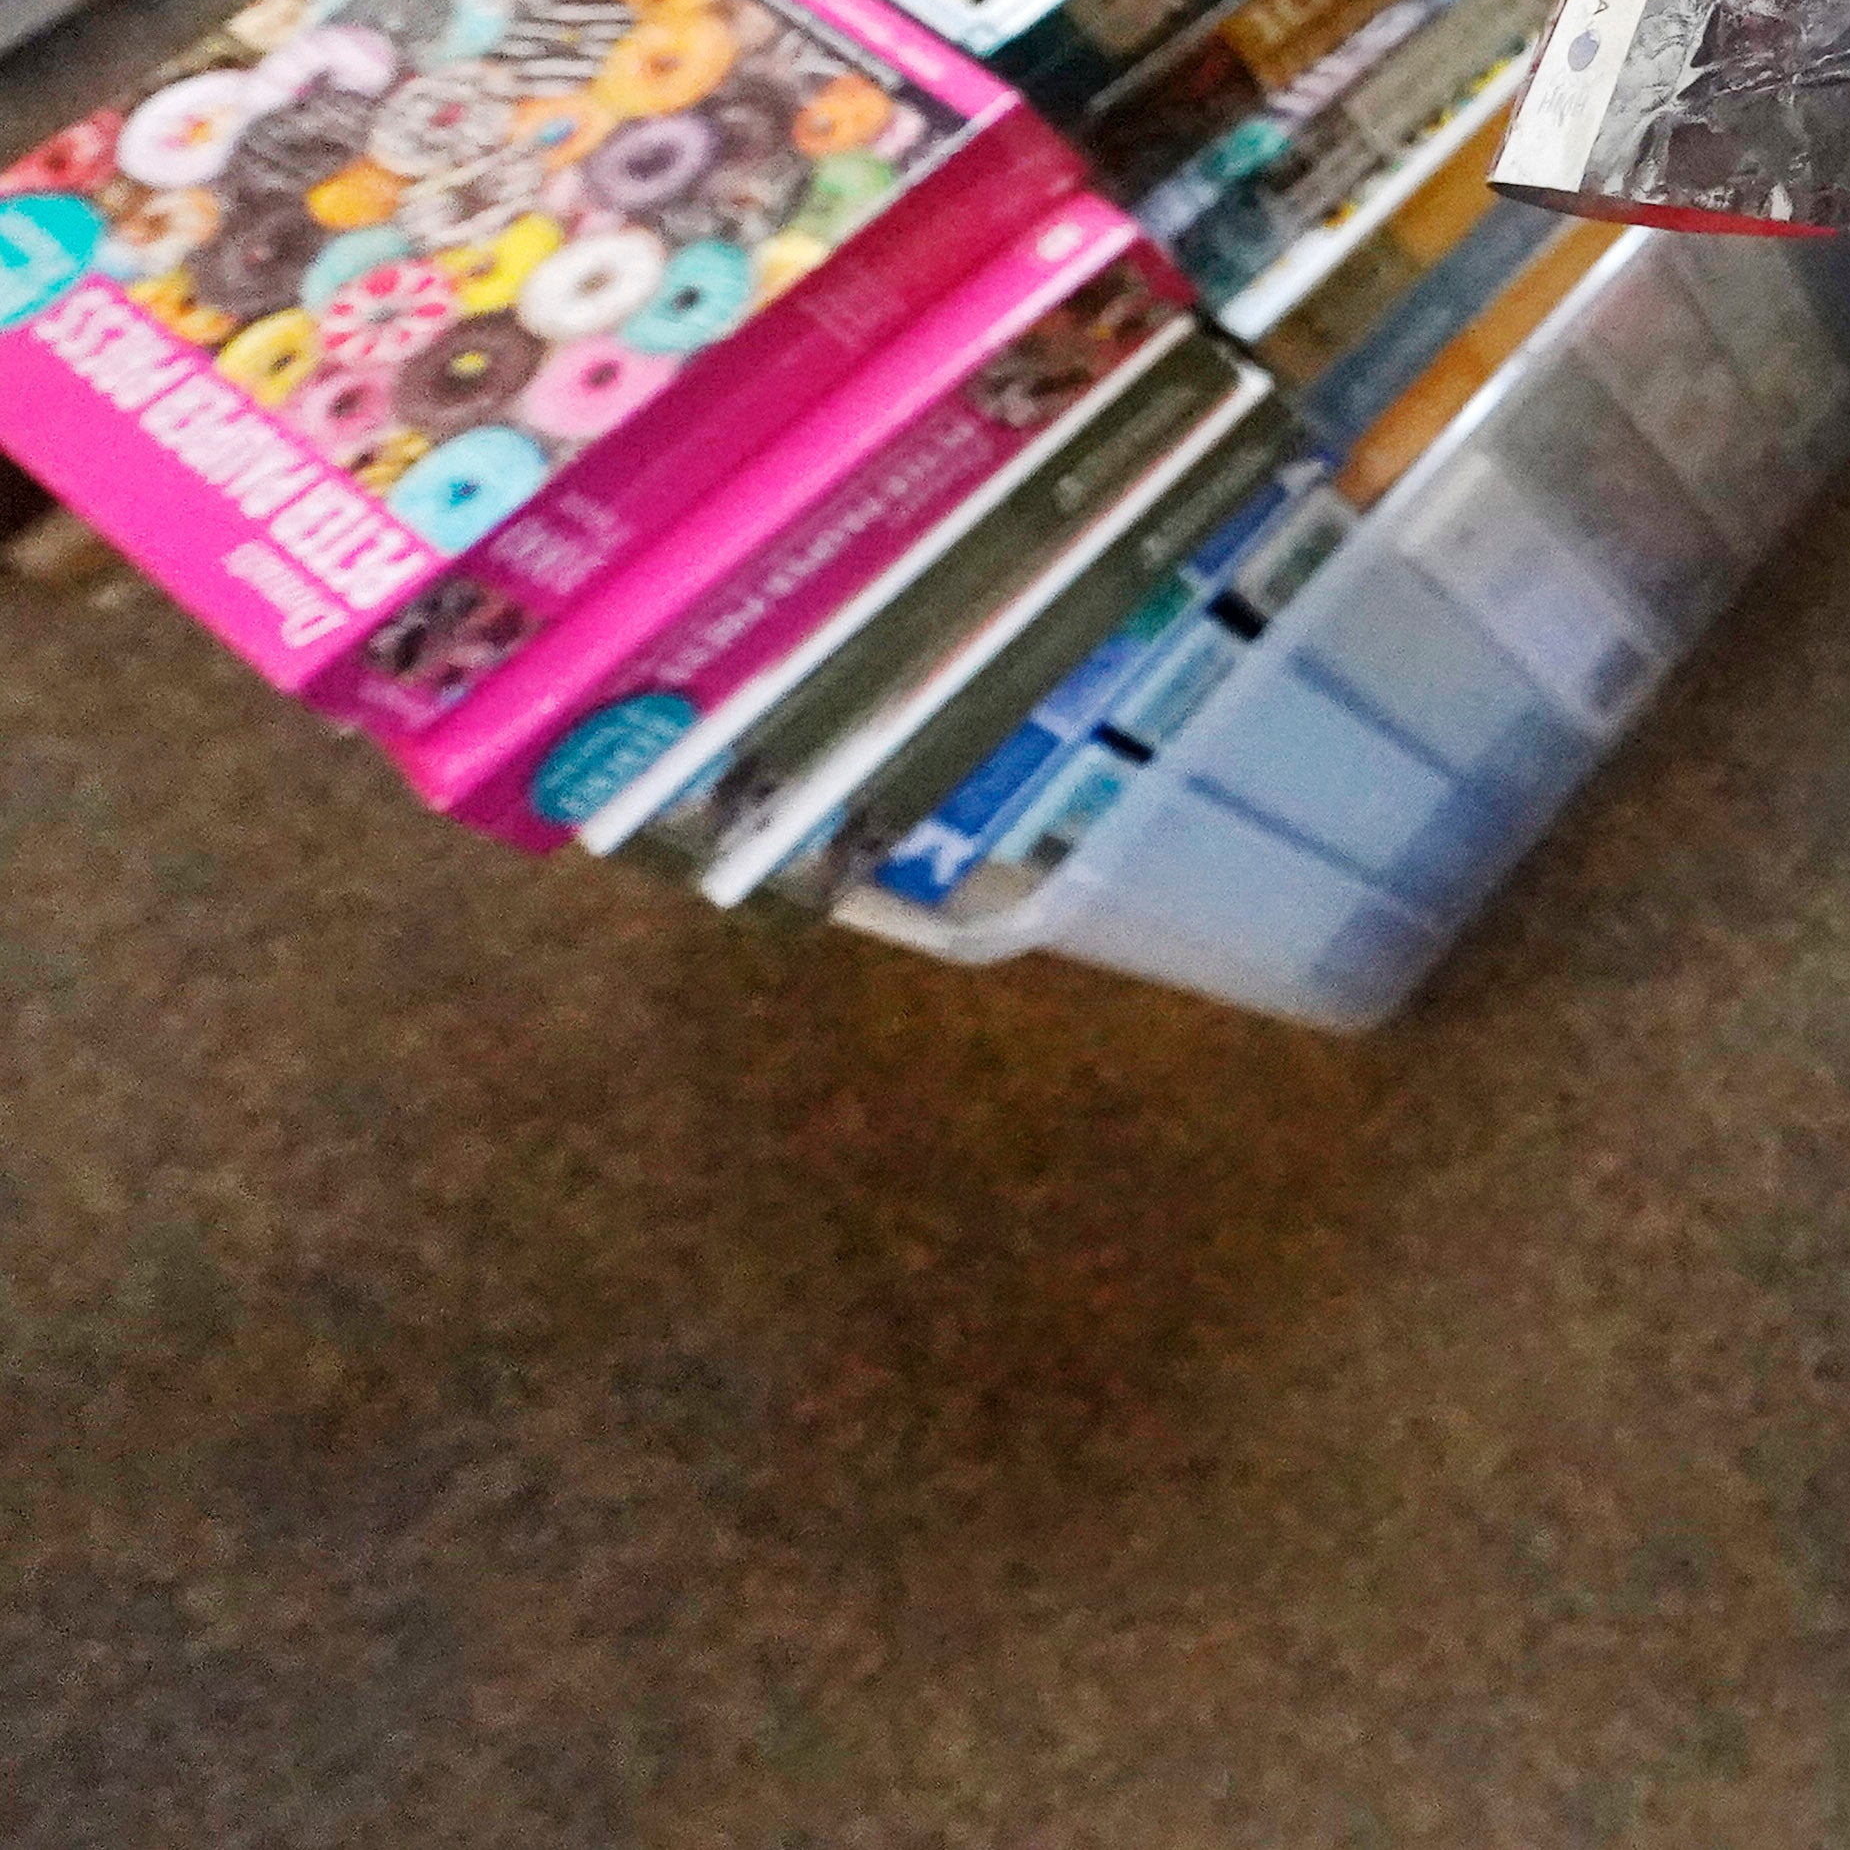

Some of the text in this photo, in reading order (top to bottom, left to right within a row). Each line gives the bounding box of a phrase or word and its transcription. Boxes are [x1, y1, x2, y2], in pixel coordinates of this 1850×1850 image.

[33, 288, 196, 412] PRESS
[139, 369, 318, 520] PAUPER
[270, 478, 430, 610] PETER
